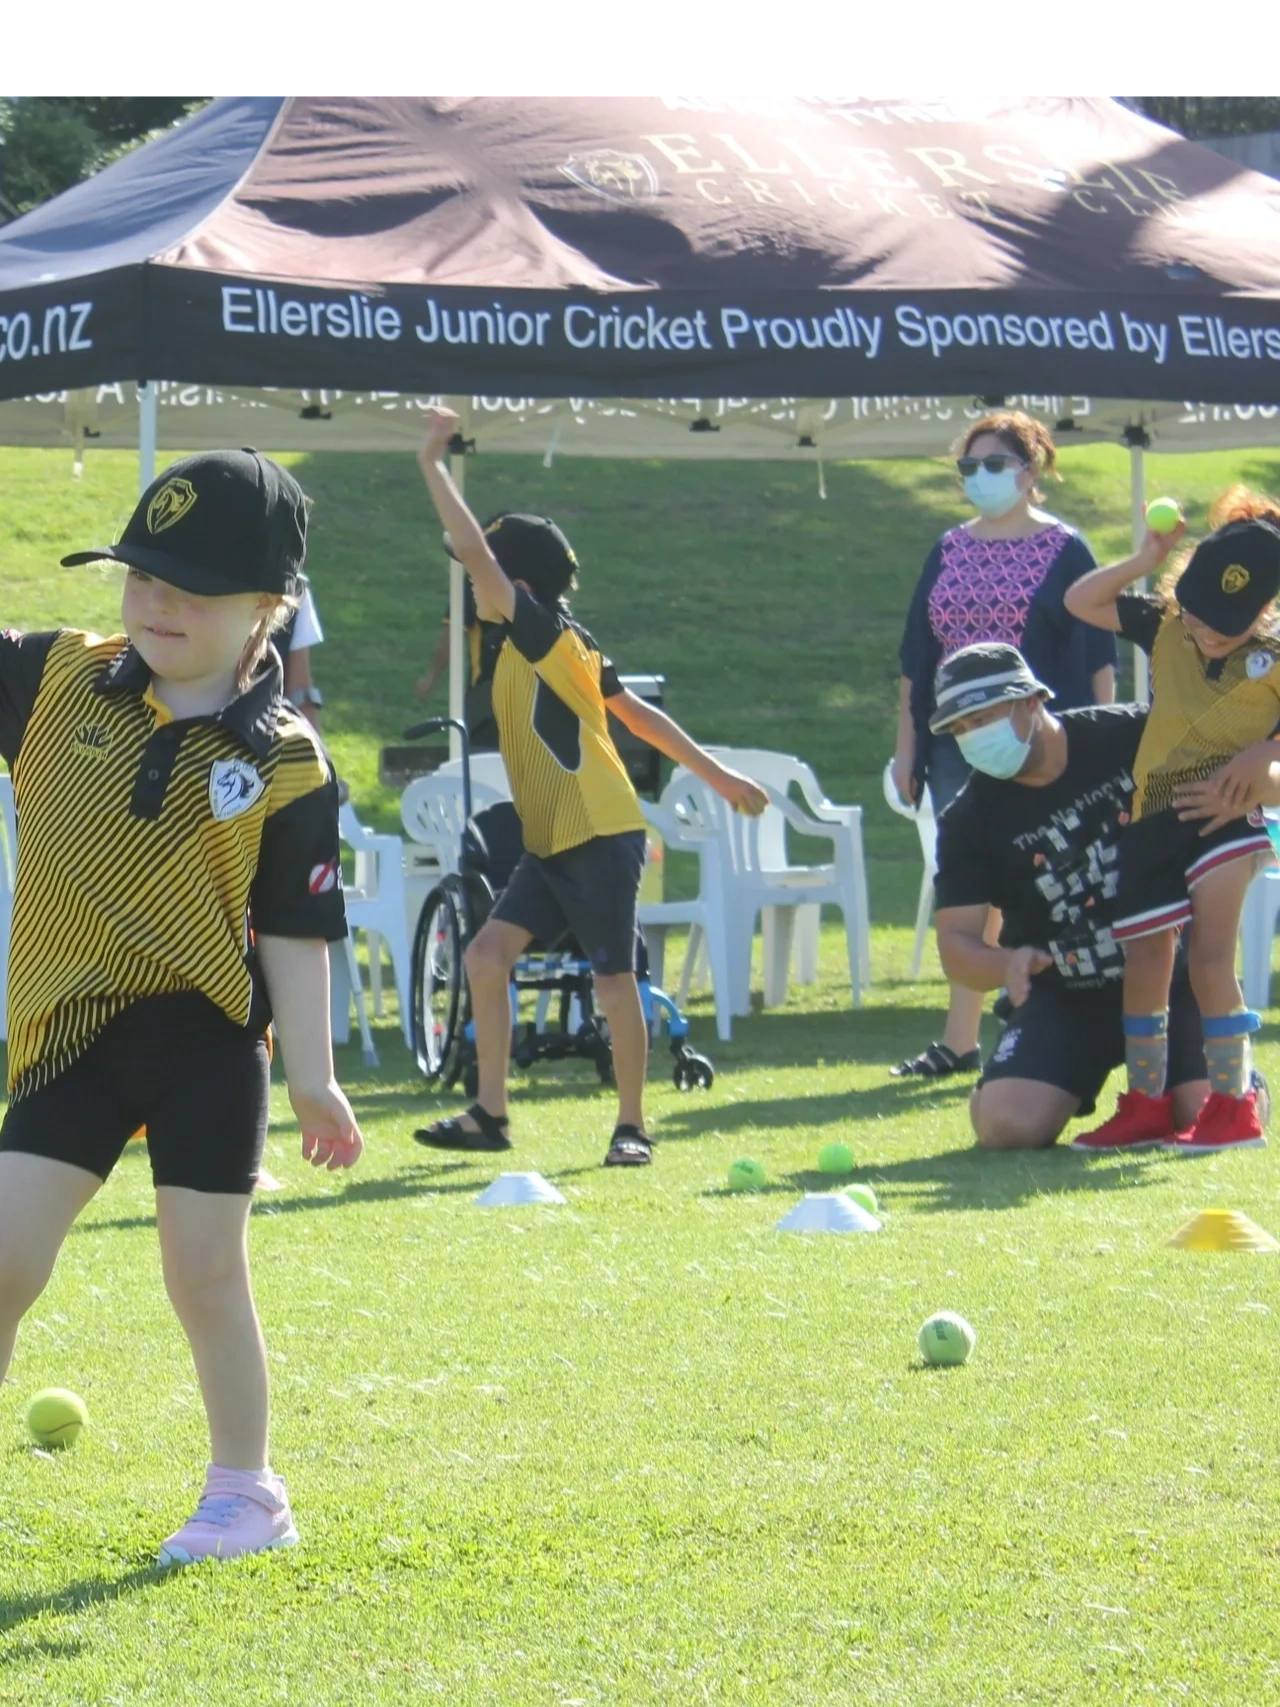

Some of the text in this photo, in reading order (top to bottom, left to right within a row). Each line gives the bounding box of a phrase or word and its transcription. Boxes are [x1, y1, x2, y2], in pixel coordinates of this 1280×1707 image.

[696, 177, 996, 220] CRICKET
[221, 286, 1280, 364] Ellerslie Junior Cricket Proudly Sponsored by Ellers
[1012, 824, 1050, 851] The
